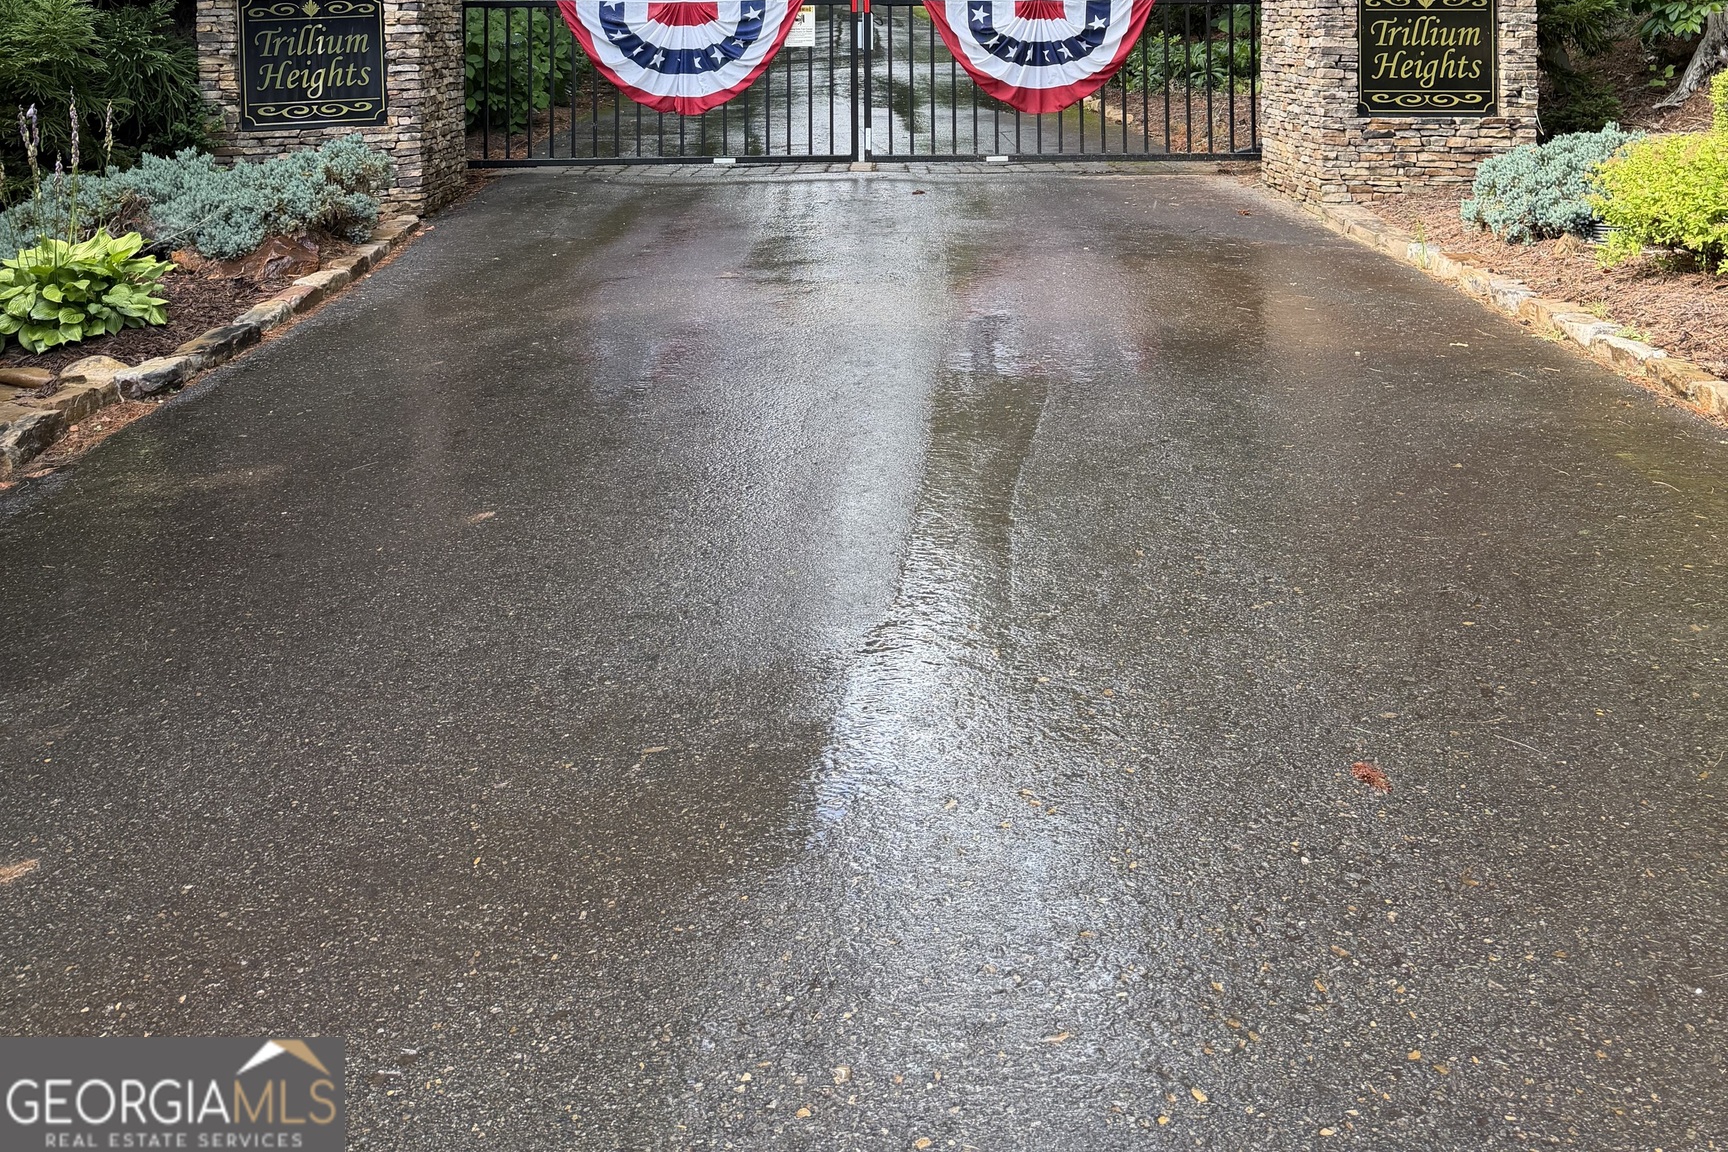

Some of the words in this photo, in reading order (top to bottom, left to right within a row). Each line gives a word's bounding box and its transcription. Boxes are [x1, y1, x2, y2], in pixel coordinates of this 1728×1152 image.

[254, 23, 370, 57] Trillium
[1370, 15, 1482, 47] Trillium
[256, 56, 372, 99] Heights
[1371, 48, 1483, 89] Heights
